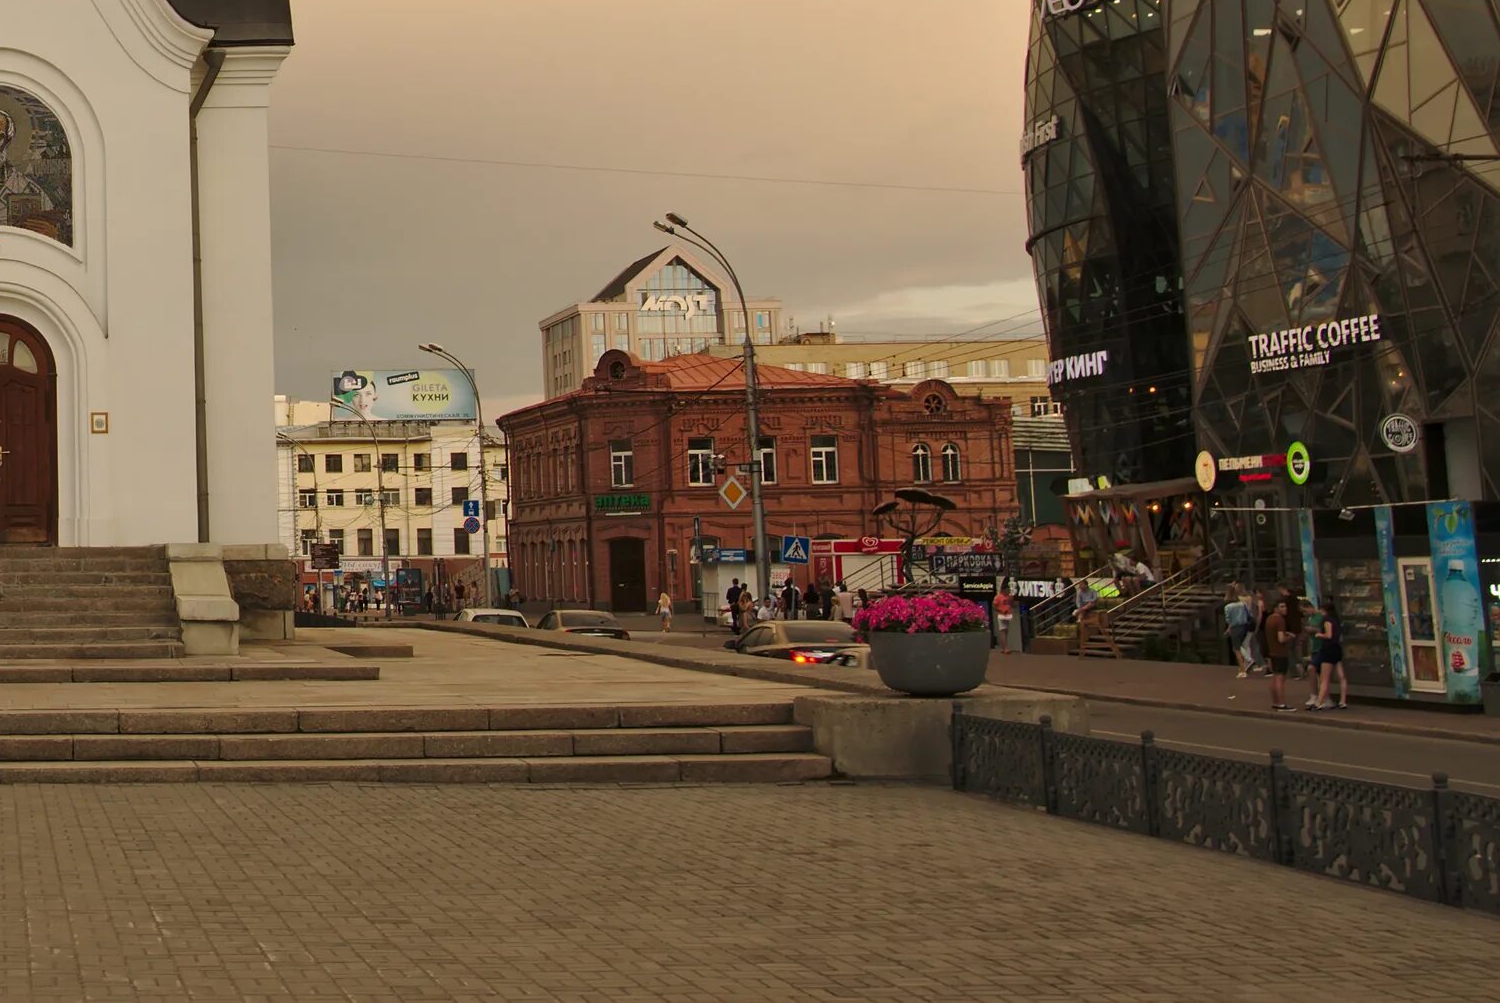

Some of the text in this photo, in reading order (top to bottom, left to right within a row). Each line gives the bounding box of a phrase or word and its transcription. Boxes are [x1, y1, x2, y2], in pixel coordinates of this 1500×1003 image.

[1248, 314, 1381, 359] TRAFFIC COFFEE
[1065, 350, 1107, 380] КИНГ
[1250, 350, 1330, 374] BUSINESS & FAMILY
[388, 372, 418, 384] raumplus
[412, 383, 449, 392] GILETA
[412, 393, 449, 402] КУХНИ
[595, 493, 651, 507] аптека
[946, 554, 993, 568] ПАРКОВКА
[962, 582, 994, 590] ServiceApple
[1017, 580, 1055, 597] ХИТЭК
